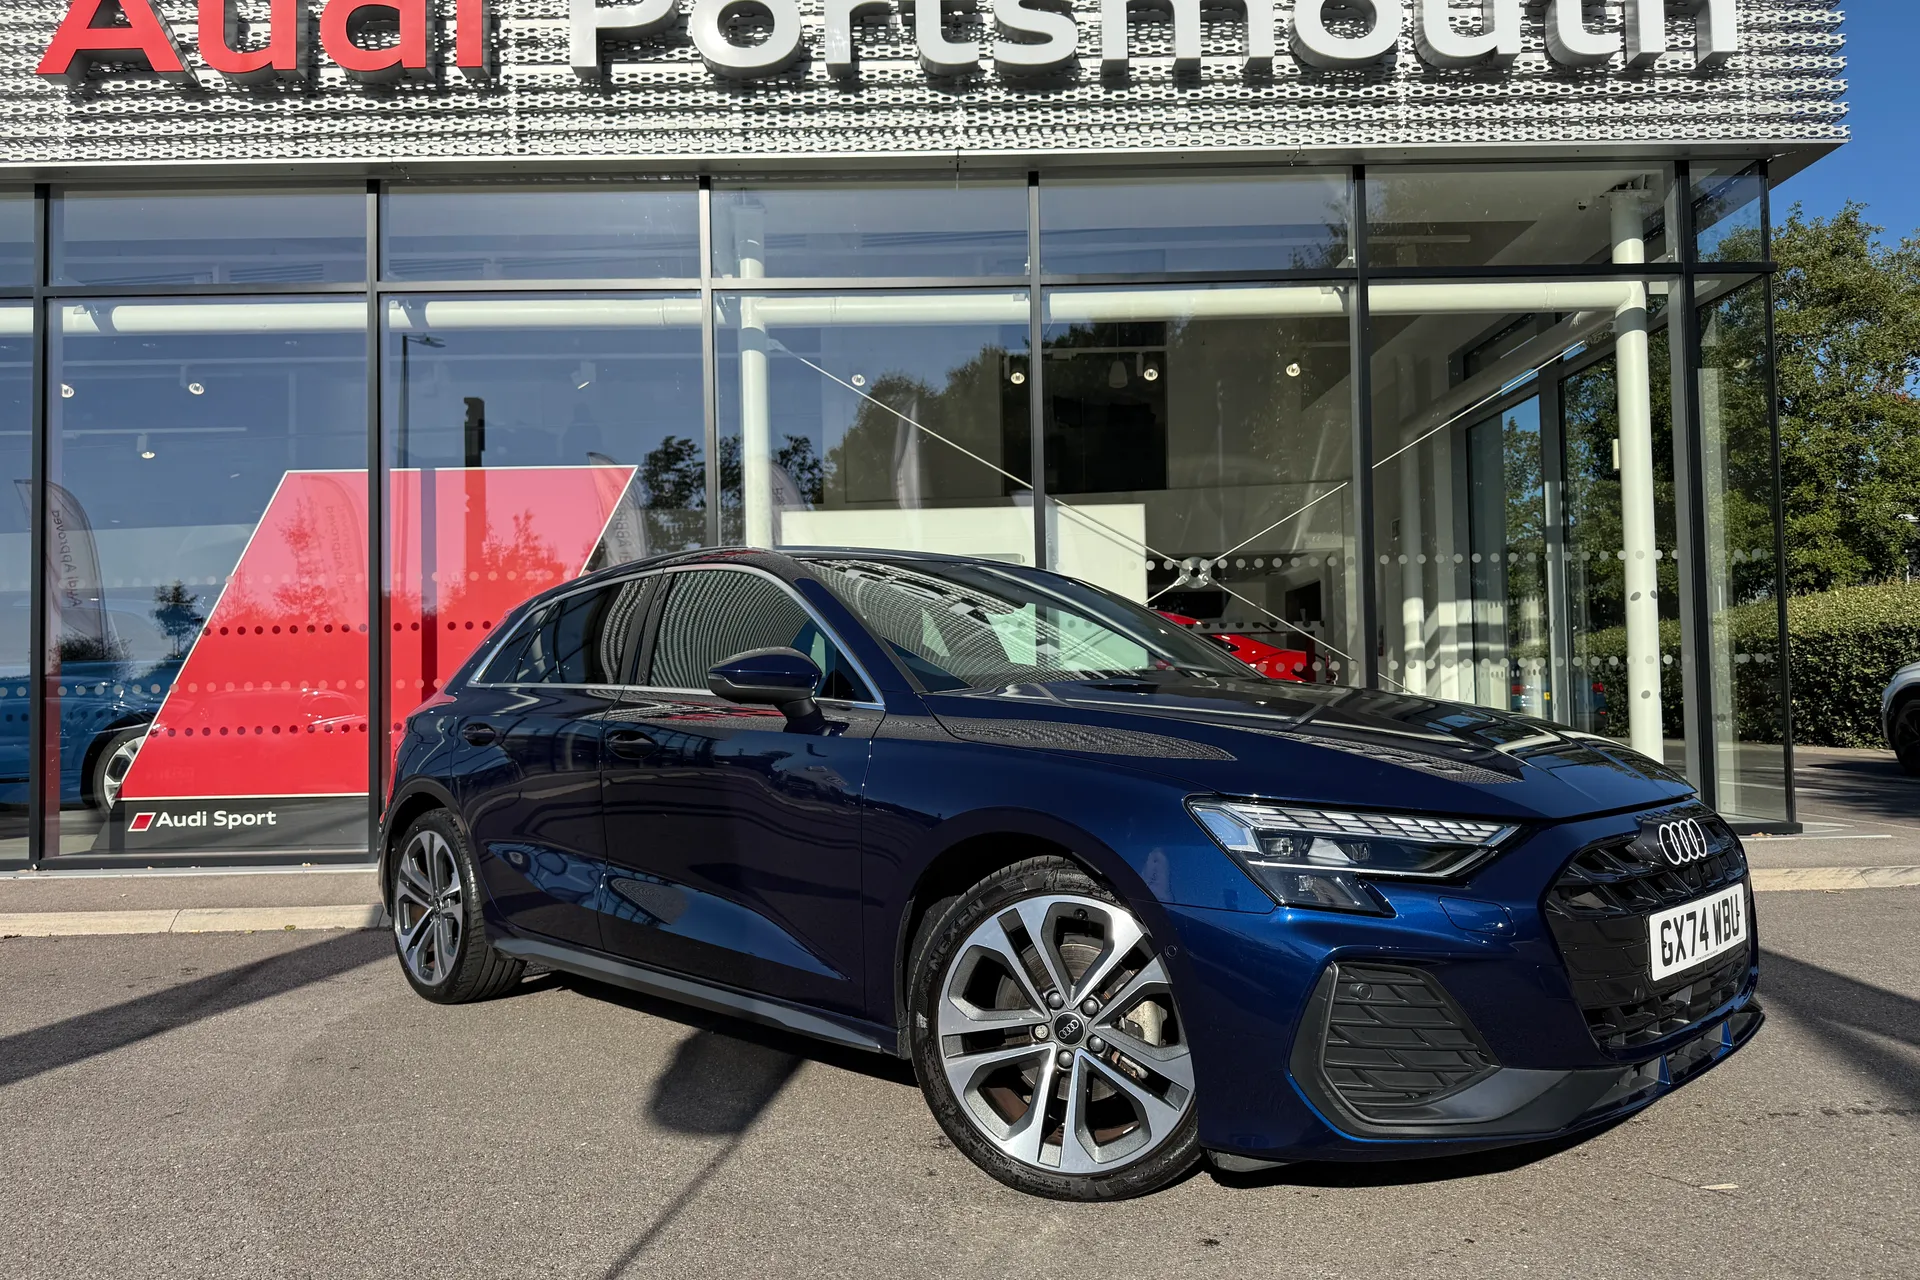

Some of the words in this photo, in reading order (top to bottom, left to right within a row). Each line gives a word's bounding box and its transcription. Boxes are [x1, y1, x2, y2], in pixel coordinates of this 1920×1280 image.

[36, 0, 485, 77] Audi
[155, 810, 207, 828] Audi
[213, 810, 277, 830] Sport
[928, 898, 987, 972] NEXEN
[1659, 906, 1710, 968] GX74
[1711, 893, 1741, 947] WBU
